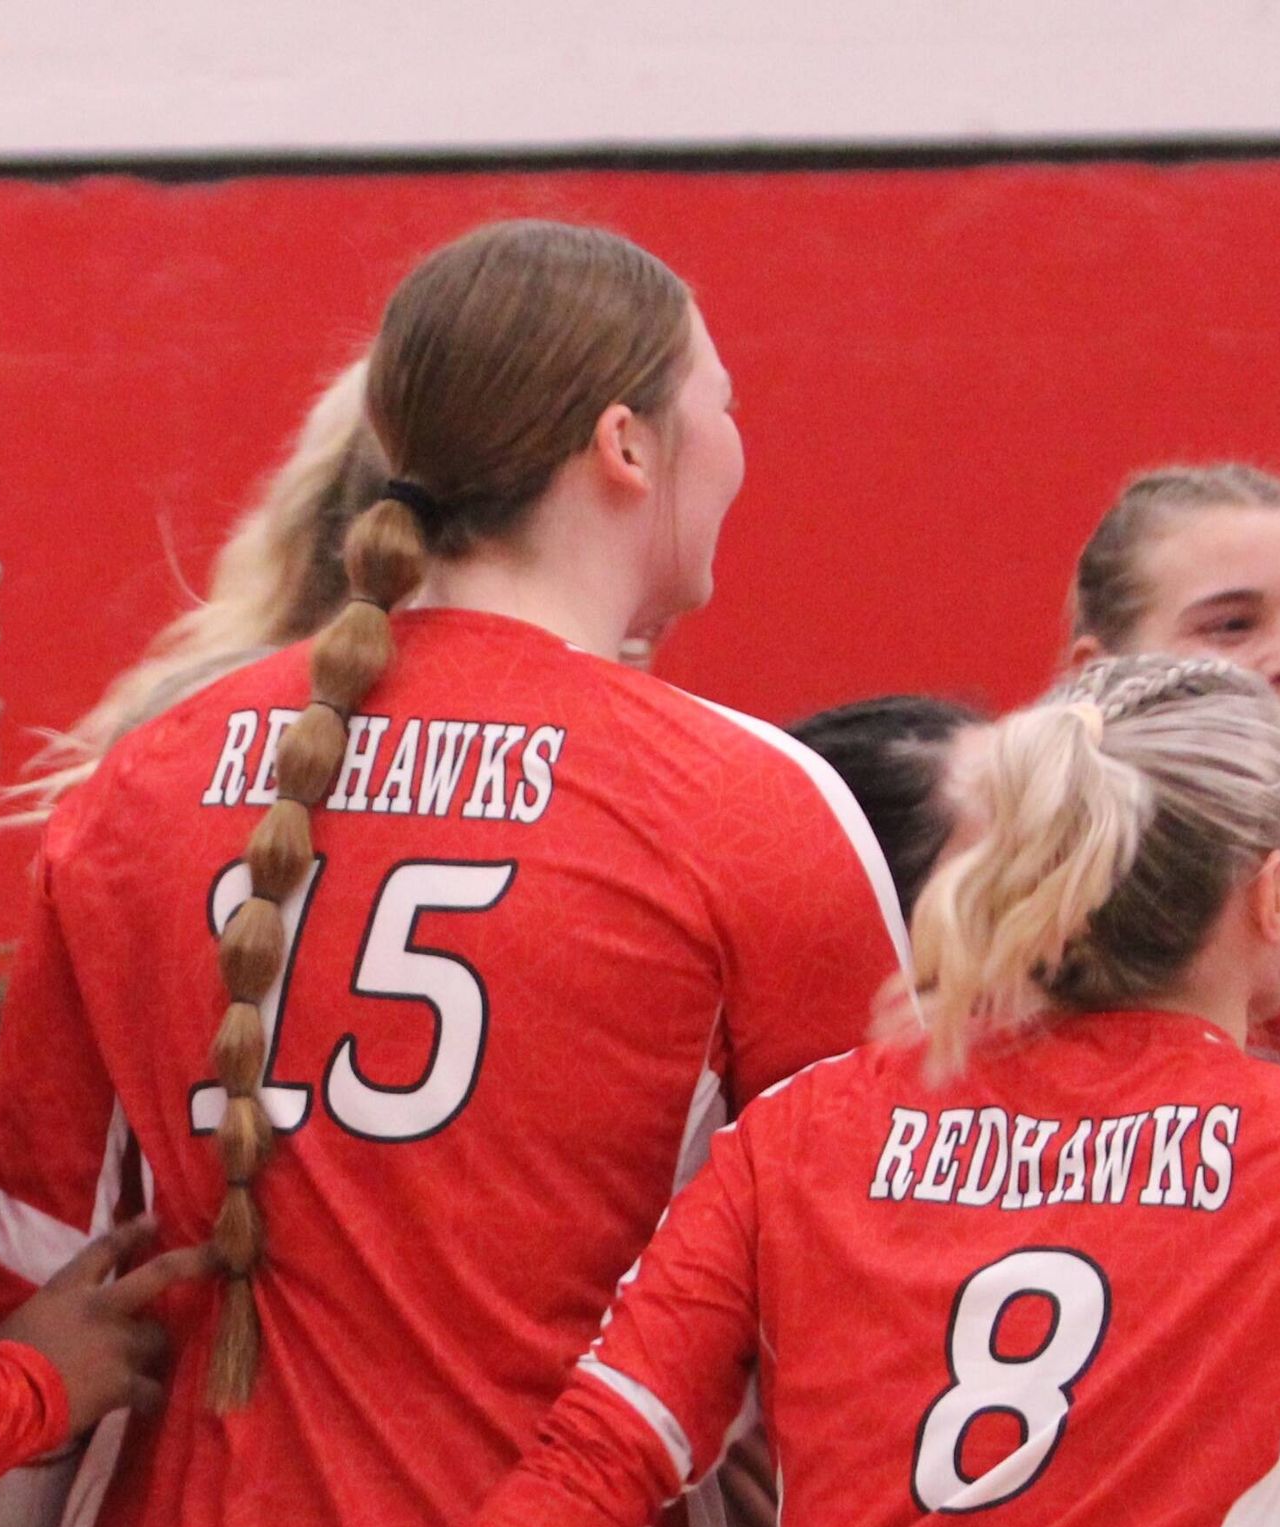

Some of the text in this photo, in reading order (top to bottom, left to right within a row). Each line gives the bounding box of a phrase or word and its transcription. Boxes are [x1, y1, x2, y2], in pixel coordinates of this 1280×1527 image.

[201, 707, 567, 825] REHAWKS
[869, 1104, 1241, 1211] REDHAWKS
[910, 1245, 1113, 1515] 8
